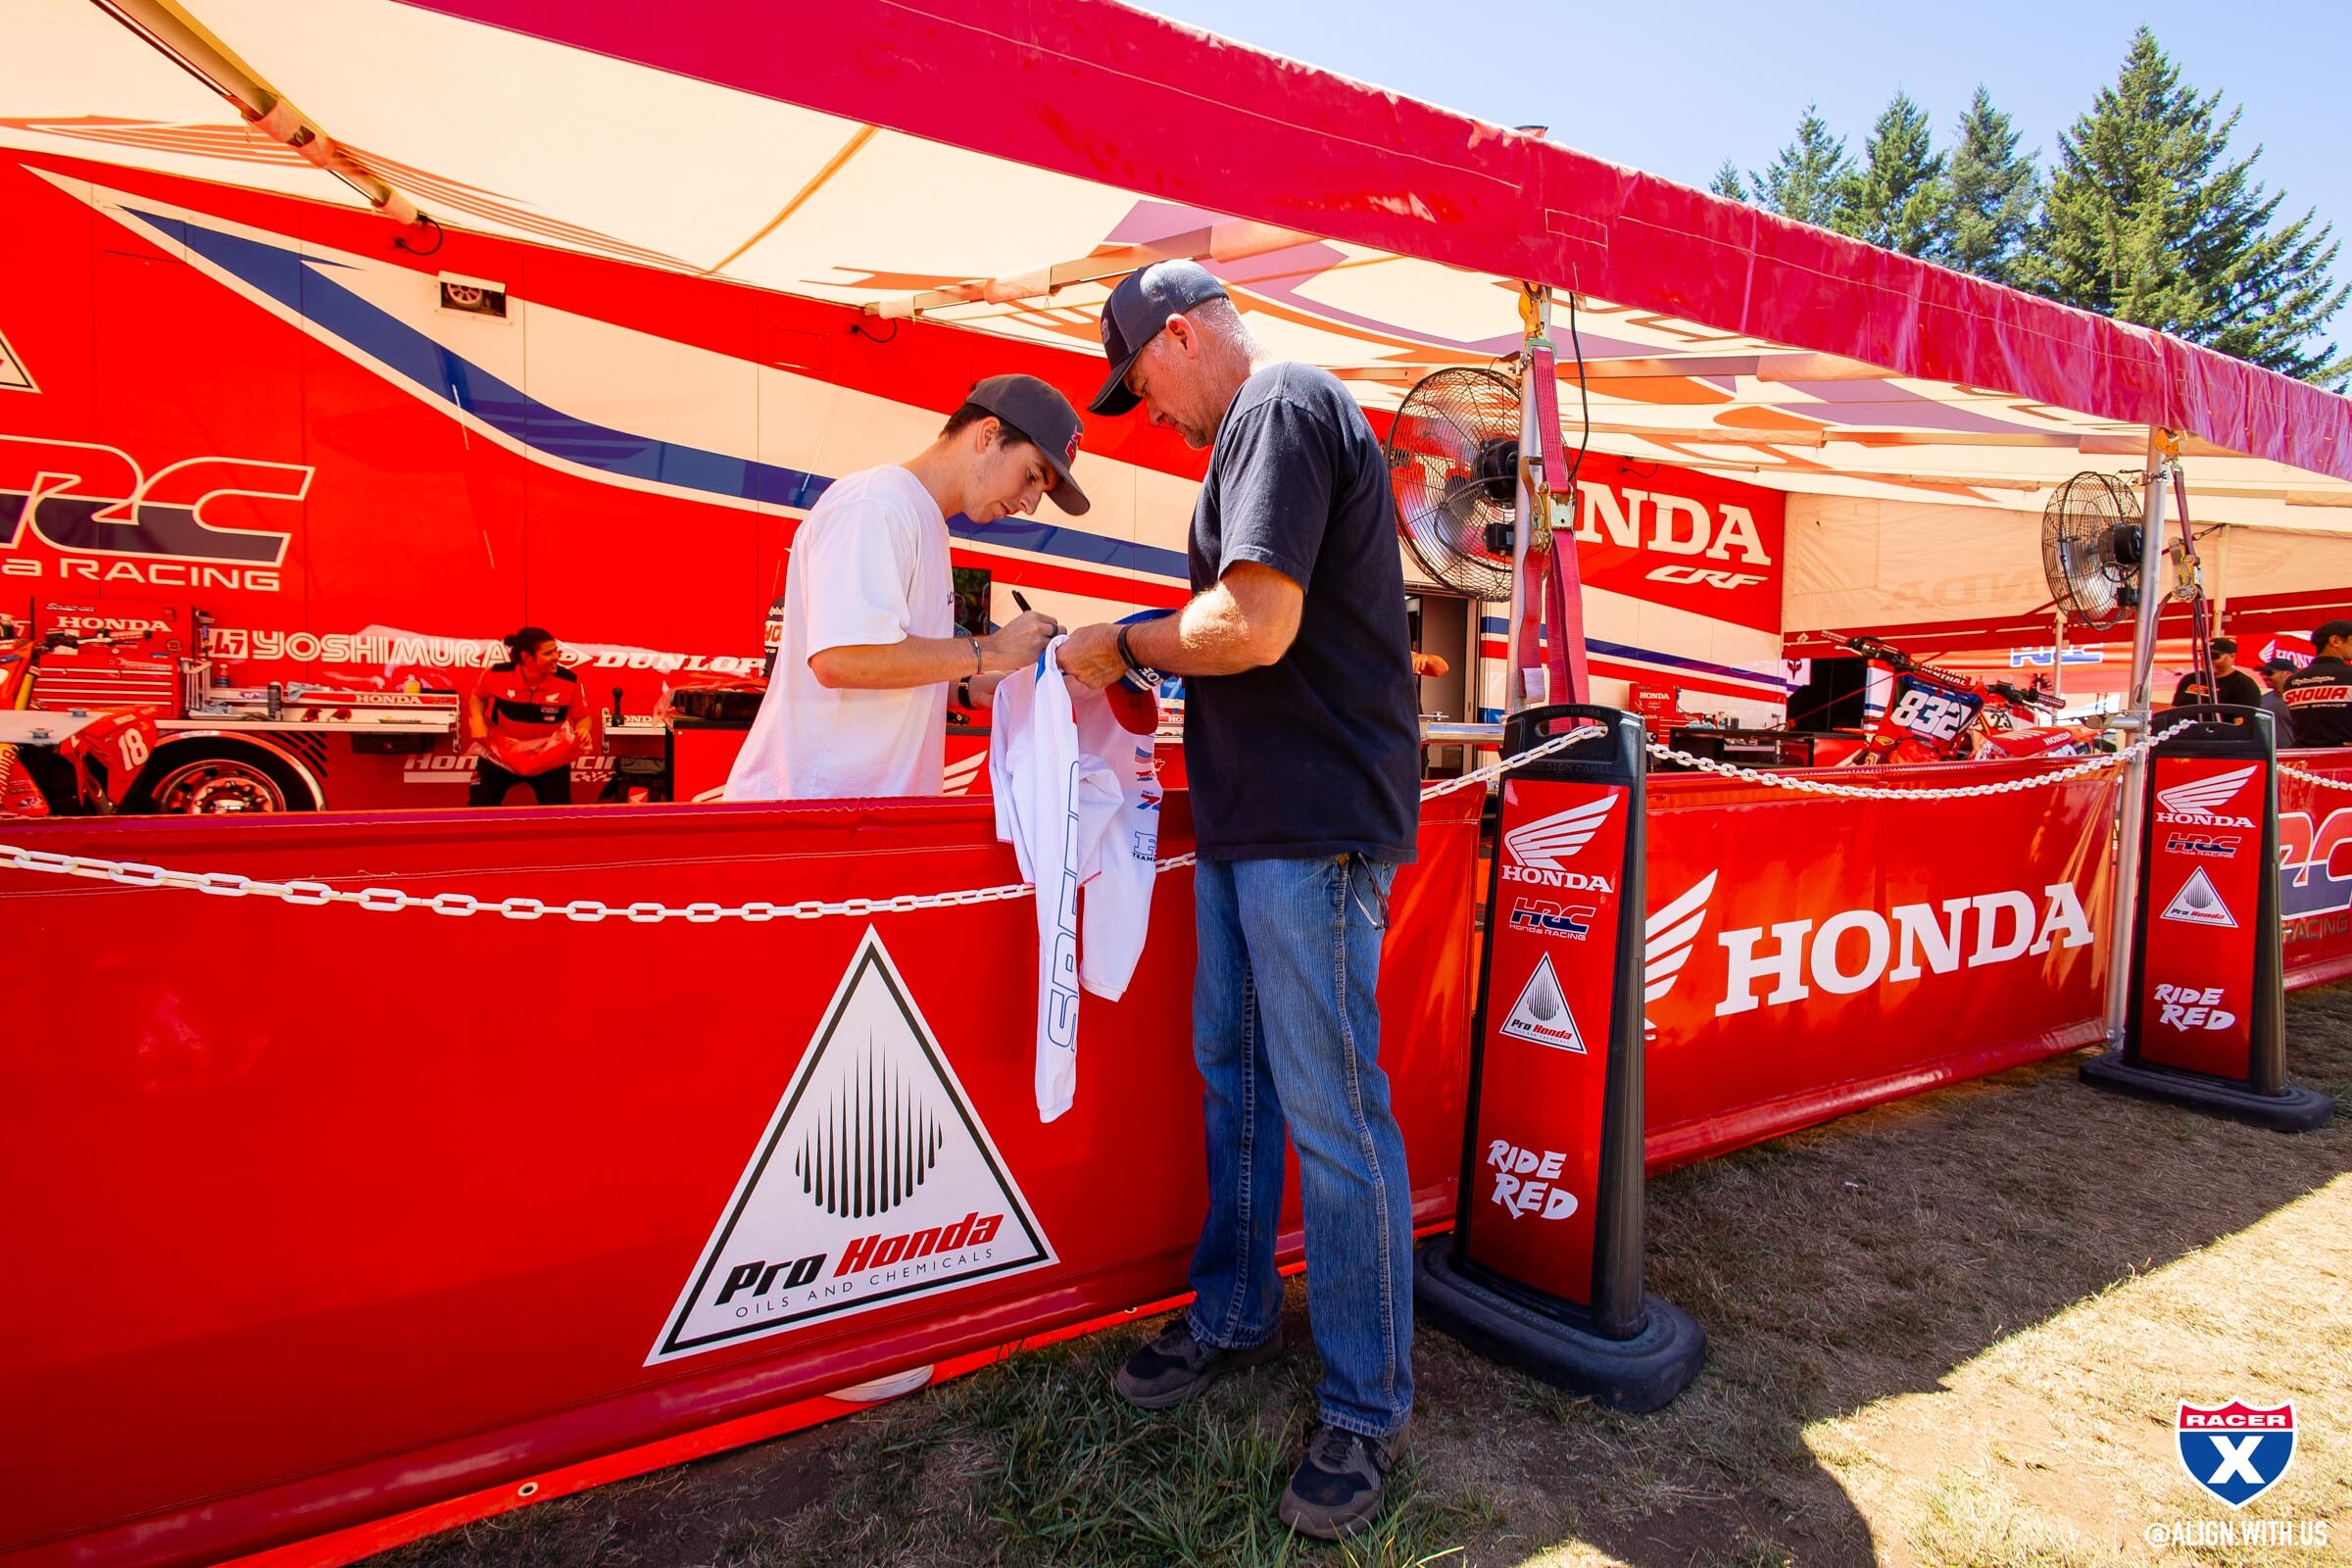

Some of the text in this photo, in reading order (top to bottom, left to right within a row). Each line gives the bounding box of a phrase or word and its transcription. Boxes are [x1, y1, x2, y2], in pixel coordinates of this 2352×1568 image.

[0, 433, 316, 568] RC
[59, 557, 280, 593] RACING
[1645, 564, 1769, 590] CRF
[56, 615, 172, 632] HONDA
[252, 629, 512, 668] YOSHIMURA
[592, 650, 766, 677] DUNLOP
[356, 694, 422, 705] HONDA
[1639, 691, 1670, 700] HONDA
[2284, 687, 2348, 705] SHOWA
[1888, 689, 1972, 742] 832
[117, 728, 149, 771] 18
[2043, 731, 2073, 746] HONDA
[404, 753, 478, 770] Hon
[2156, 811, 2256, 828] HONDA
[2165, 832, 2241, 854] HRC
[2278, 808, 2352, 920] RC
[1501, 864, 1614, 894] HONDA
[1509, 897, 1596, 935] HRC
[2189, 909, 2227, 920] Honda
[1509, 923, 1587, 942] Honda RACING
[1714, 881, 2095, 1017] HONDA
[2153, 983, 2226, 1005] RIDE
[1510, 1018, 1574, 1041] Pro Honda
[2159, 1004, 2236, 1032] RED
[1486, 1139, 1567, 1179] RIDE
[1491, 1173, 1579, 1220] RED
[713, 1211, 1005, 1306] Pro Honda
[735, 1248, 994, 1318] OILS AND CHEMICALS
